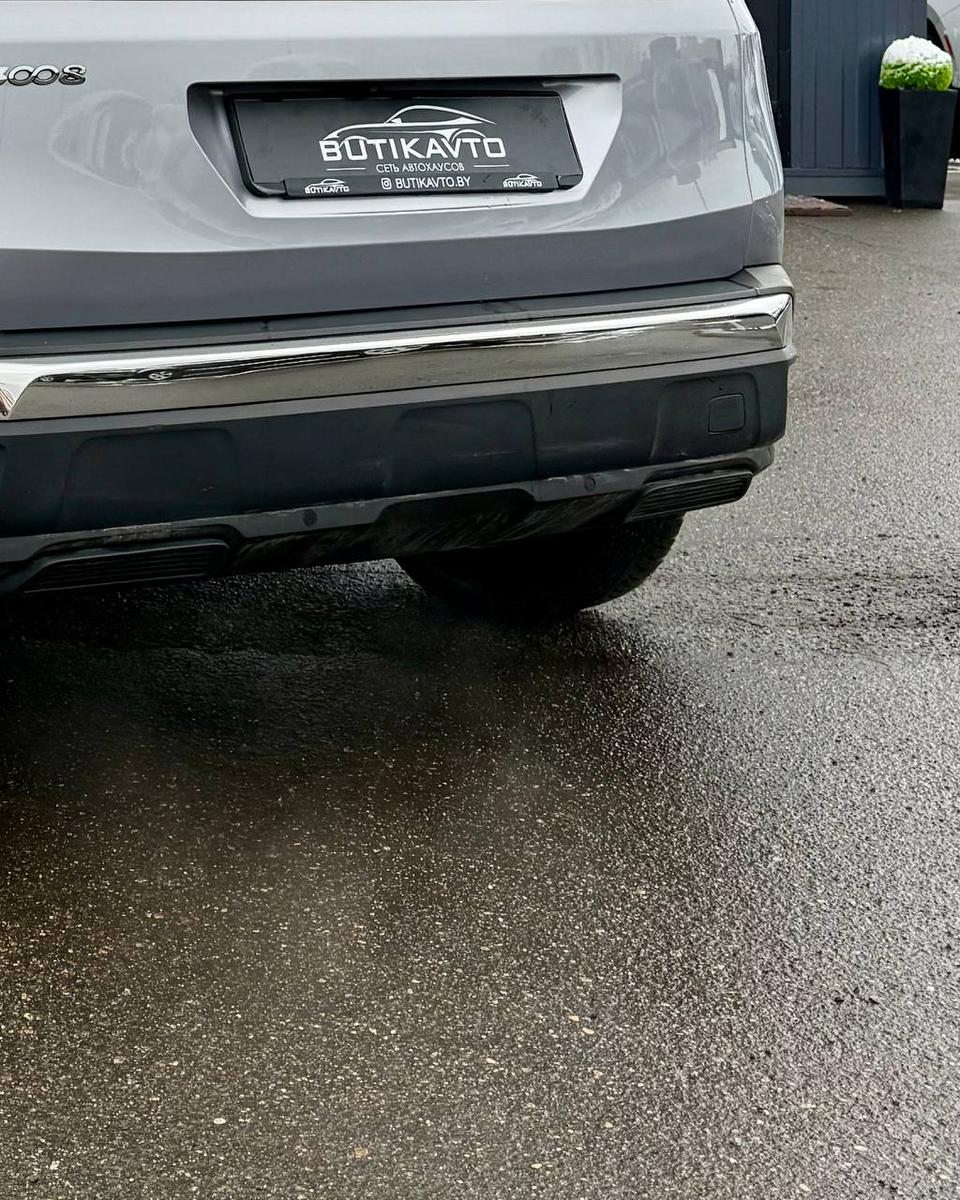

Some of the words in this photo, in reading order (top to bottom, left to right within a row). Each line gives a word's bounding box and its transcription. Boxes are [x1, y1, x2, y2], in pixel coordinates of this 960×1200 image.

[319, 137, 507, 163] BUTIKAVTO
[376, 164, 400, 174] СЕТЬ
[402, 162, 465, 173] АВТОХАУСОВ
[395, 176, 471, 189] BUTIKAVTO.BY
